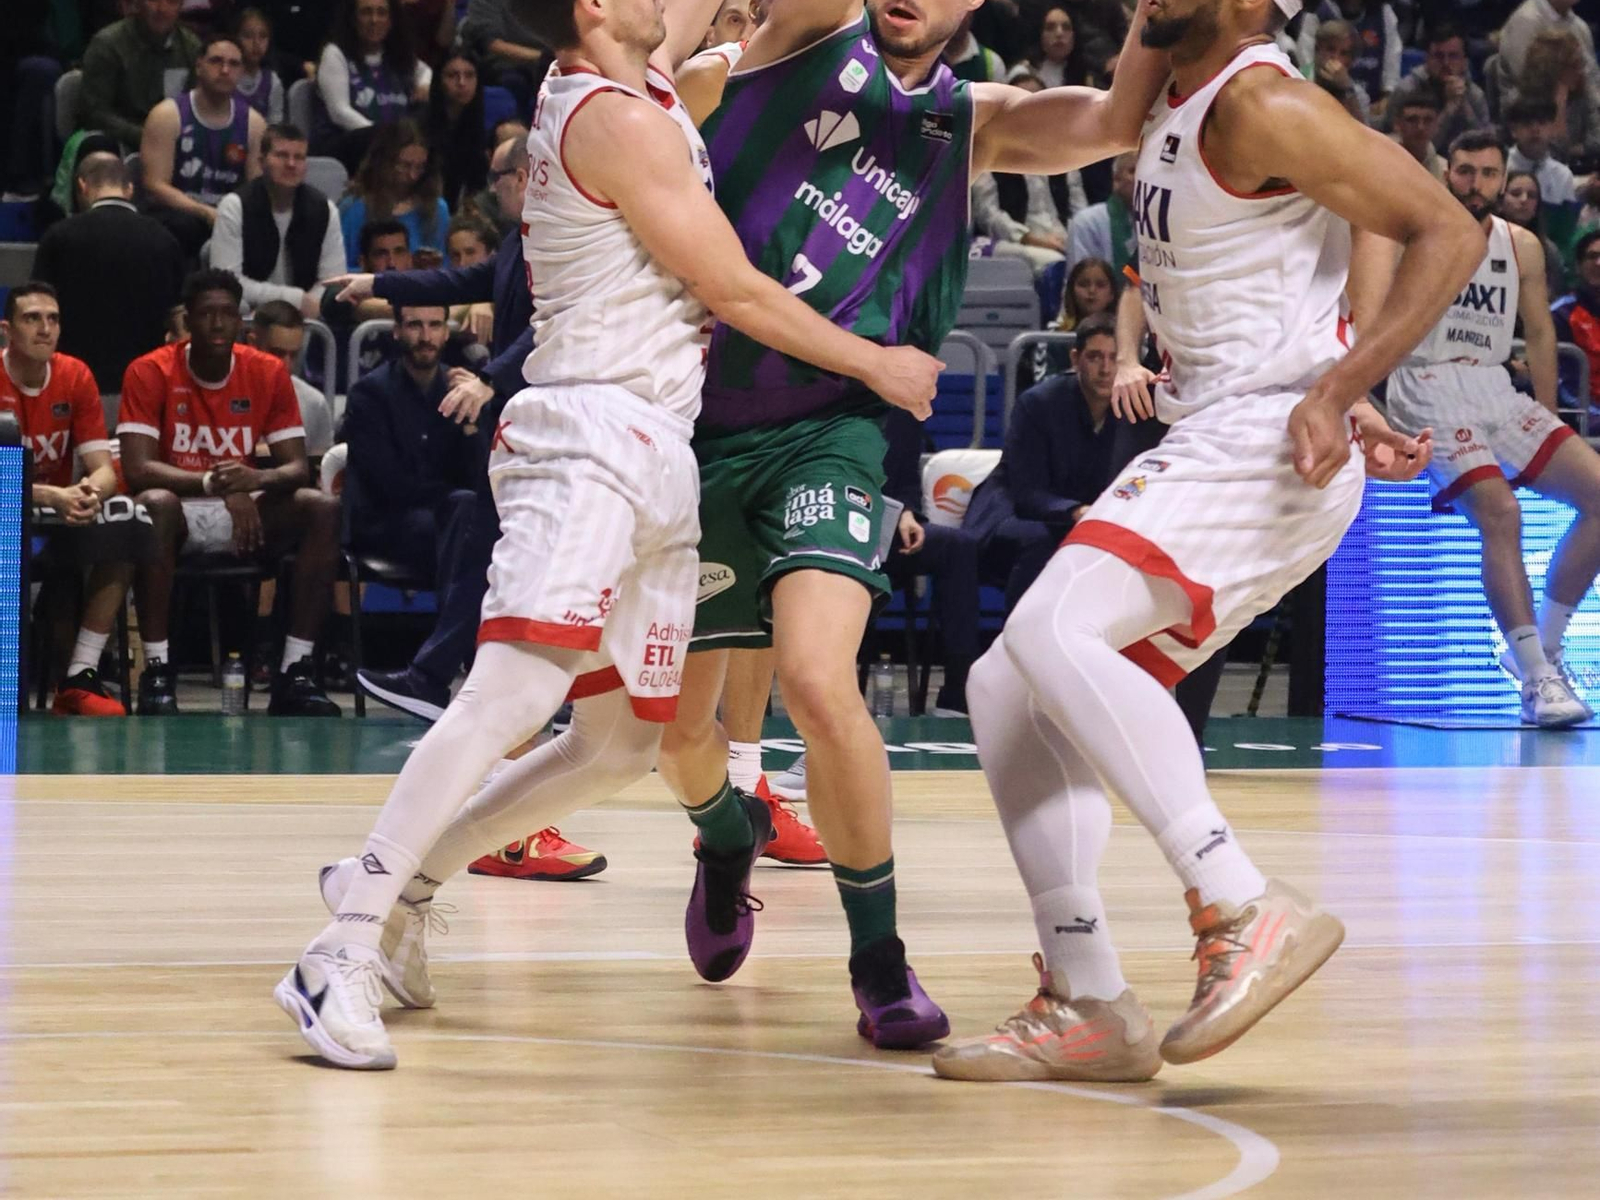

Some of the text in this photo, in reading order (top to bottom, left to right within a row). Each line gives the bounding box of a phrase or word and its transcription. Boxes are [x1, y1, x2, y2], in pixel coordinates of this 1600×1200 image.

[794, 181, 884, 259] málaga
[1132, 180, 1172, 243] AXI
[172, 422, 253, 457] BAXI
[699, 569, 730, 587] esa
[644, 644, 674, 666] ETL
